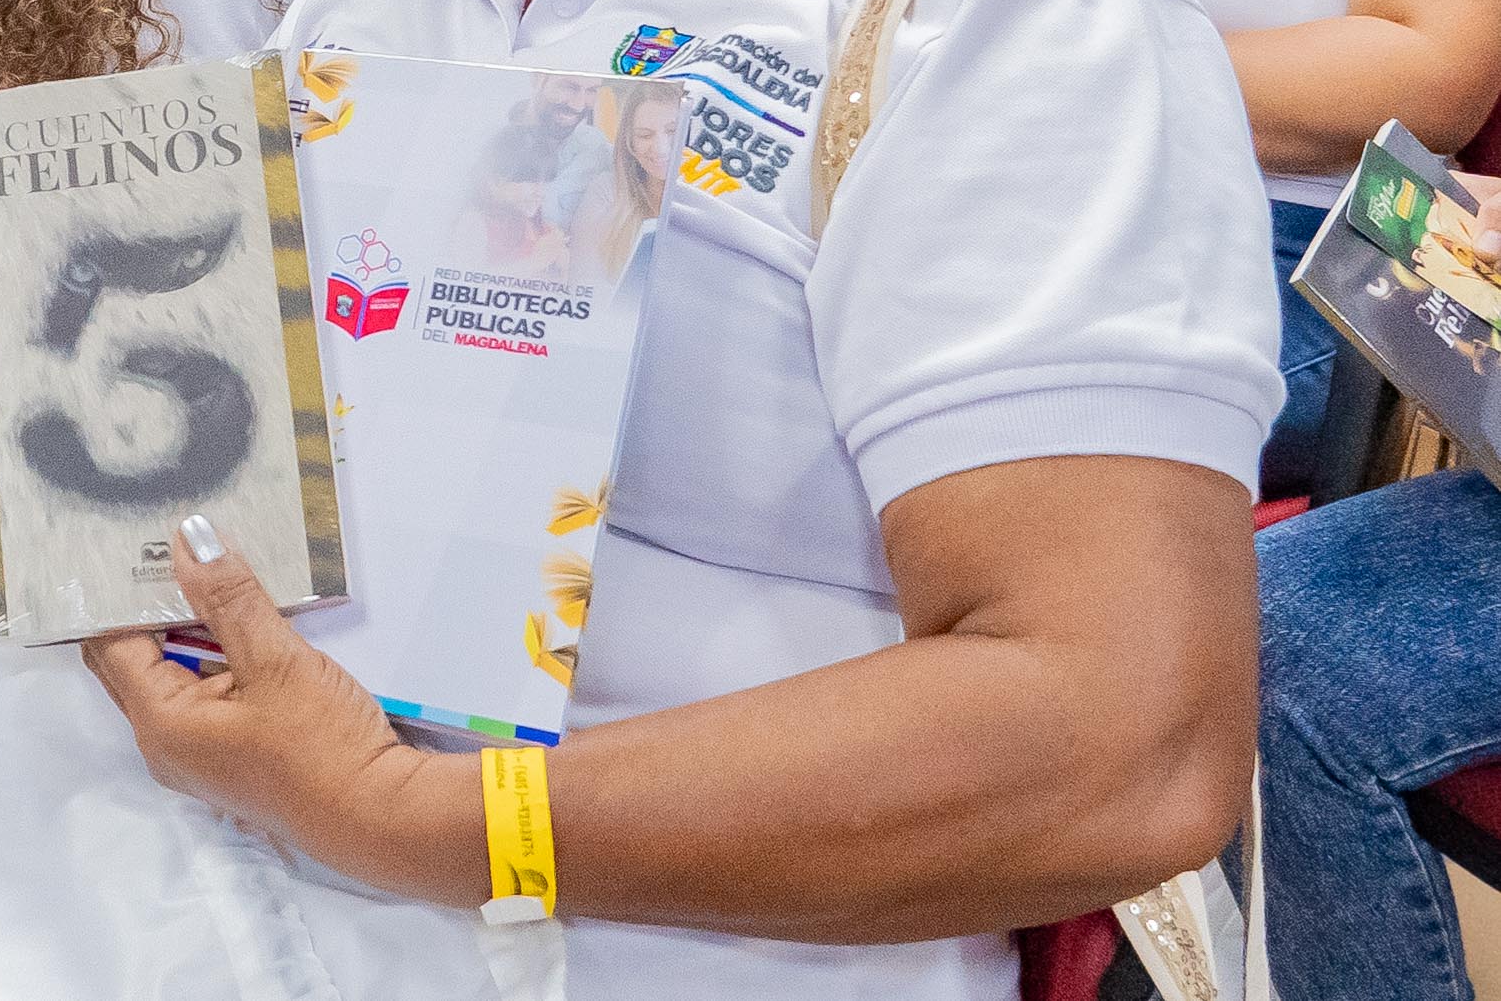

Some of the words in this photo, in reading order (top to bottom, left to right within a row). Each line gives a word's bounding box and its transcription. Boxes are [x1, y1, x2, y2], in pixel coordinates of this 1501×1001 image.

[792, 68, 824, 89] del
[4, 94, 217, 152] CUENTOS
[691, 96, 795, 169] JORES
[434, 267, 461, 281] RED
[464, 271, 571, 295] DEPARTAMENTAL
[575, 285, 595, 299] DE
[431, 282, 592, 320] BIBLIOTECAS
[426, 304, 547, 339] PÚBLICAS
[422, 328, 449, 344] DEL
[454, 332, 548, 357] MAGDALENA
